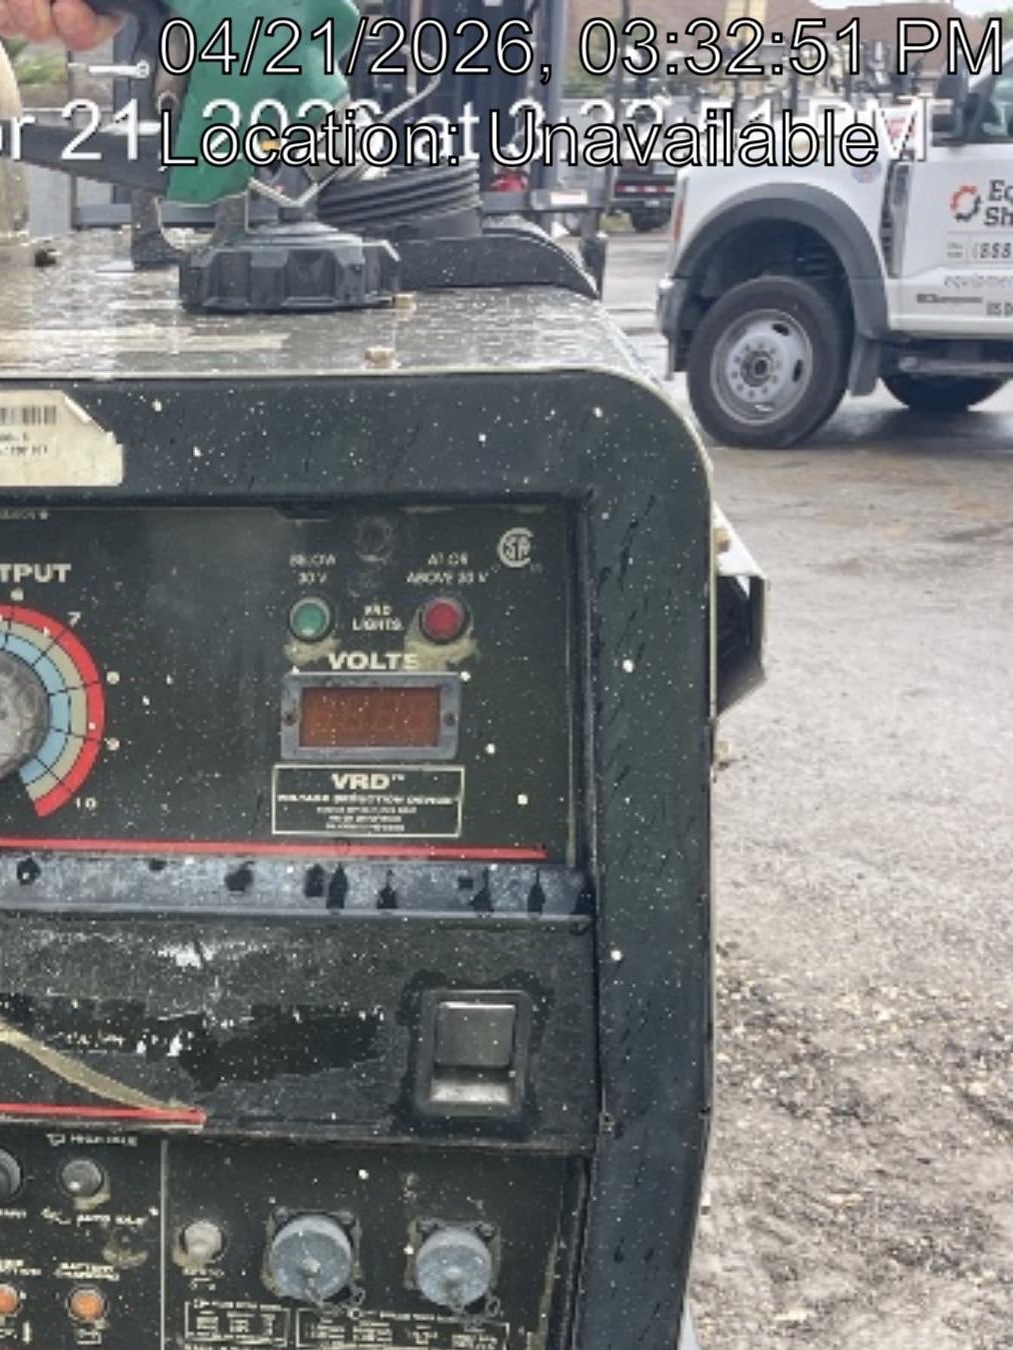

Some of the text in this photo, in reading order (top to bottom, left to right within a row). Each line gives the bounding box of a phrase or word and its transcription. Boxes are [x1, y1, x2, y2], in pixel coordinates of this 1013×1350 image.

[68, 612, 82, 626] 7
[328, 653, 420, 671] VOLTS
[76, 797, 97, 810] 10
